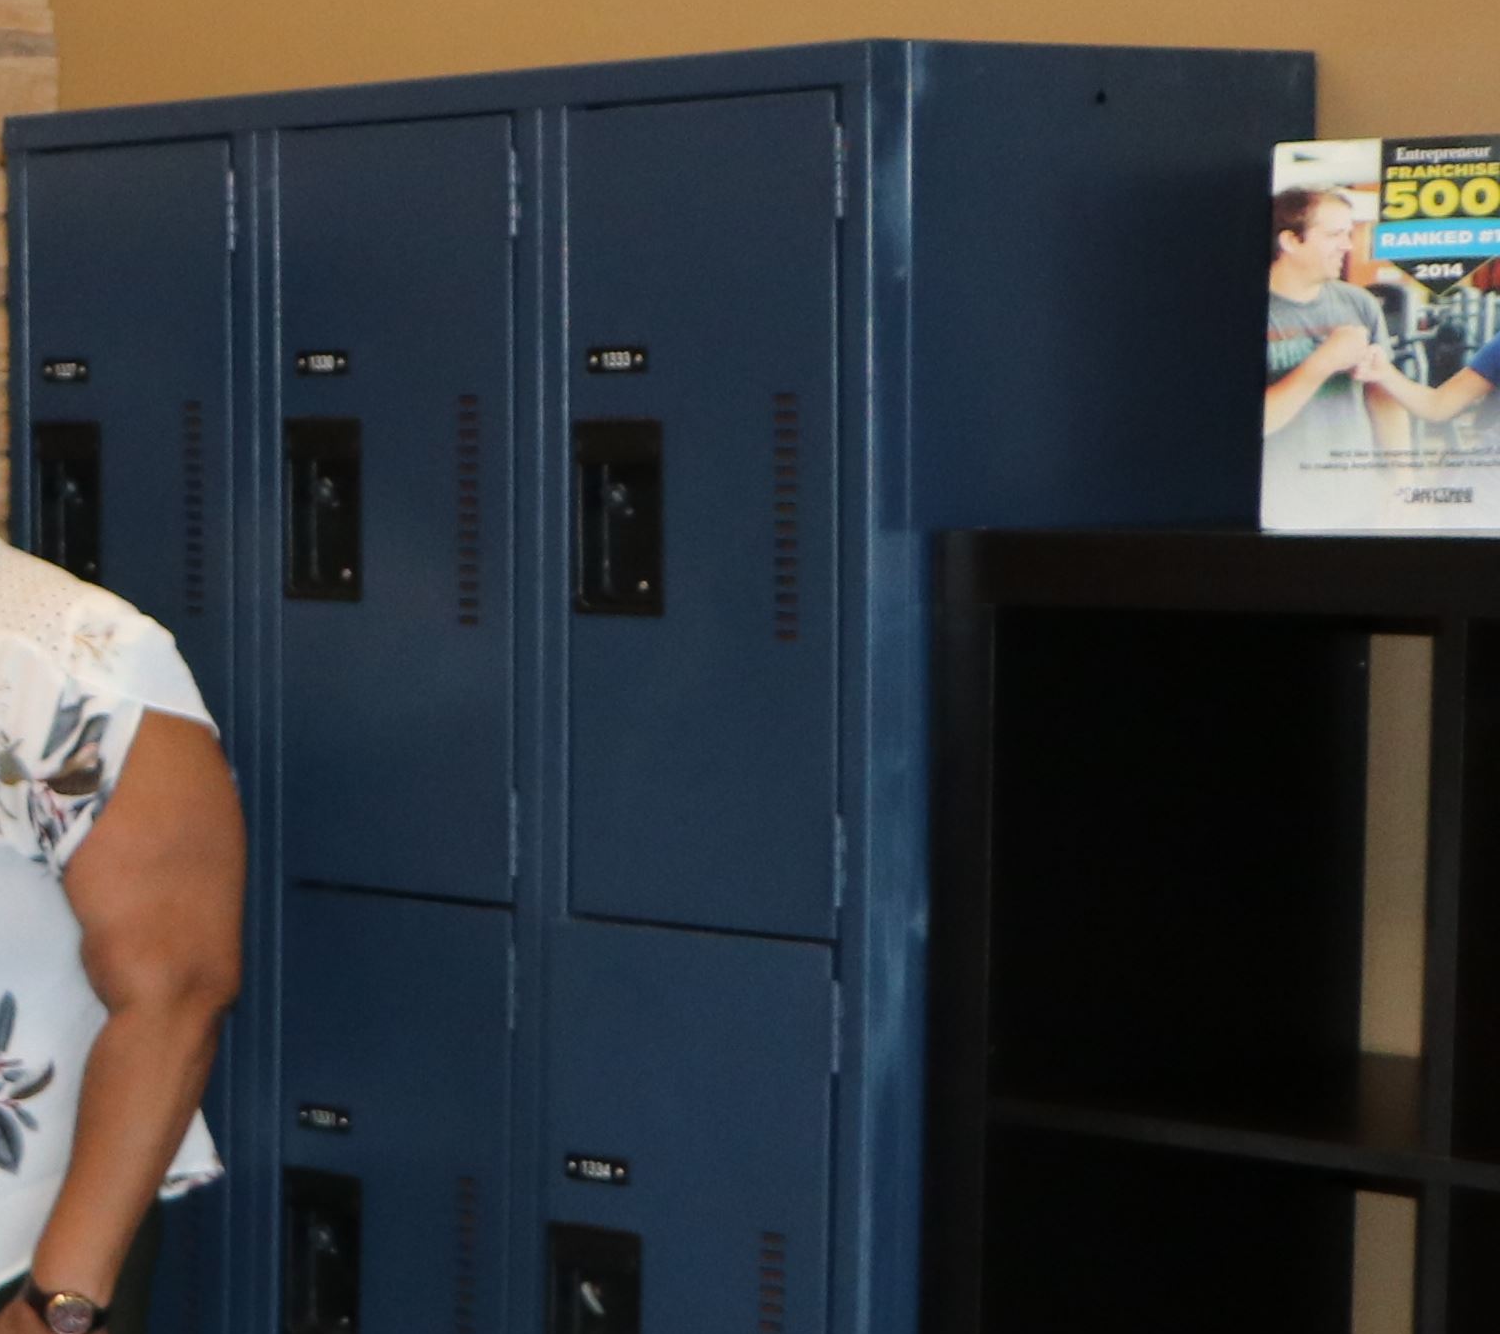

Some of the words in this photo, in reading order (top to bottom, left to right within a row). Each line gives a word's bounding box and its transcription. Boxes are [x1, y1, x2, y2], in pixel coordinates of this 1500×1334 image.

[1395, 145, 1492, 163] Entrepreneur
[1387, 161, 1500, 179] FRANCHISE
[1383, 177, 1500, 218] 500
[1381, 230, 1474, 247] RANKED
[1414, 262, 1463, 278] 2014
